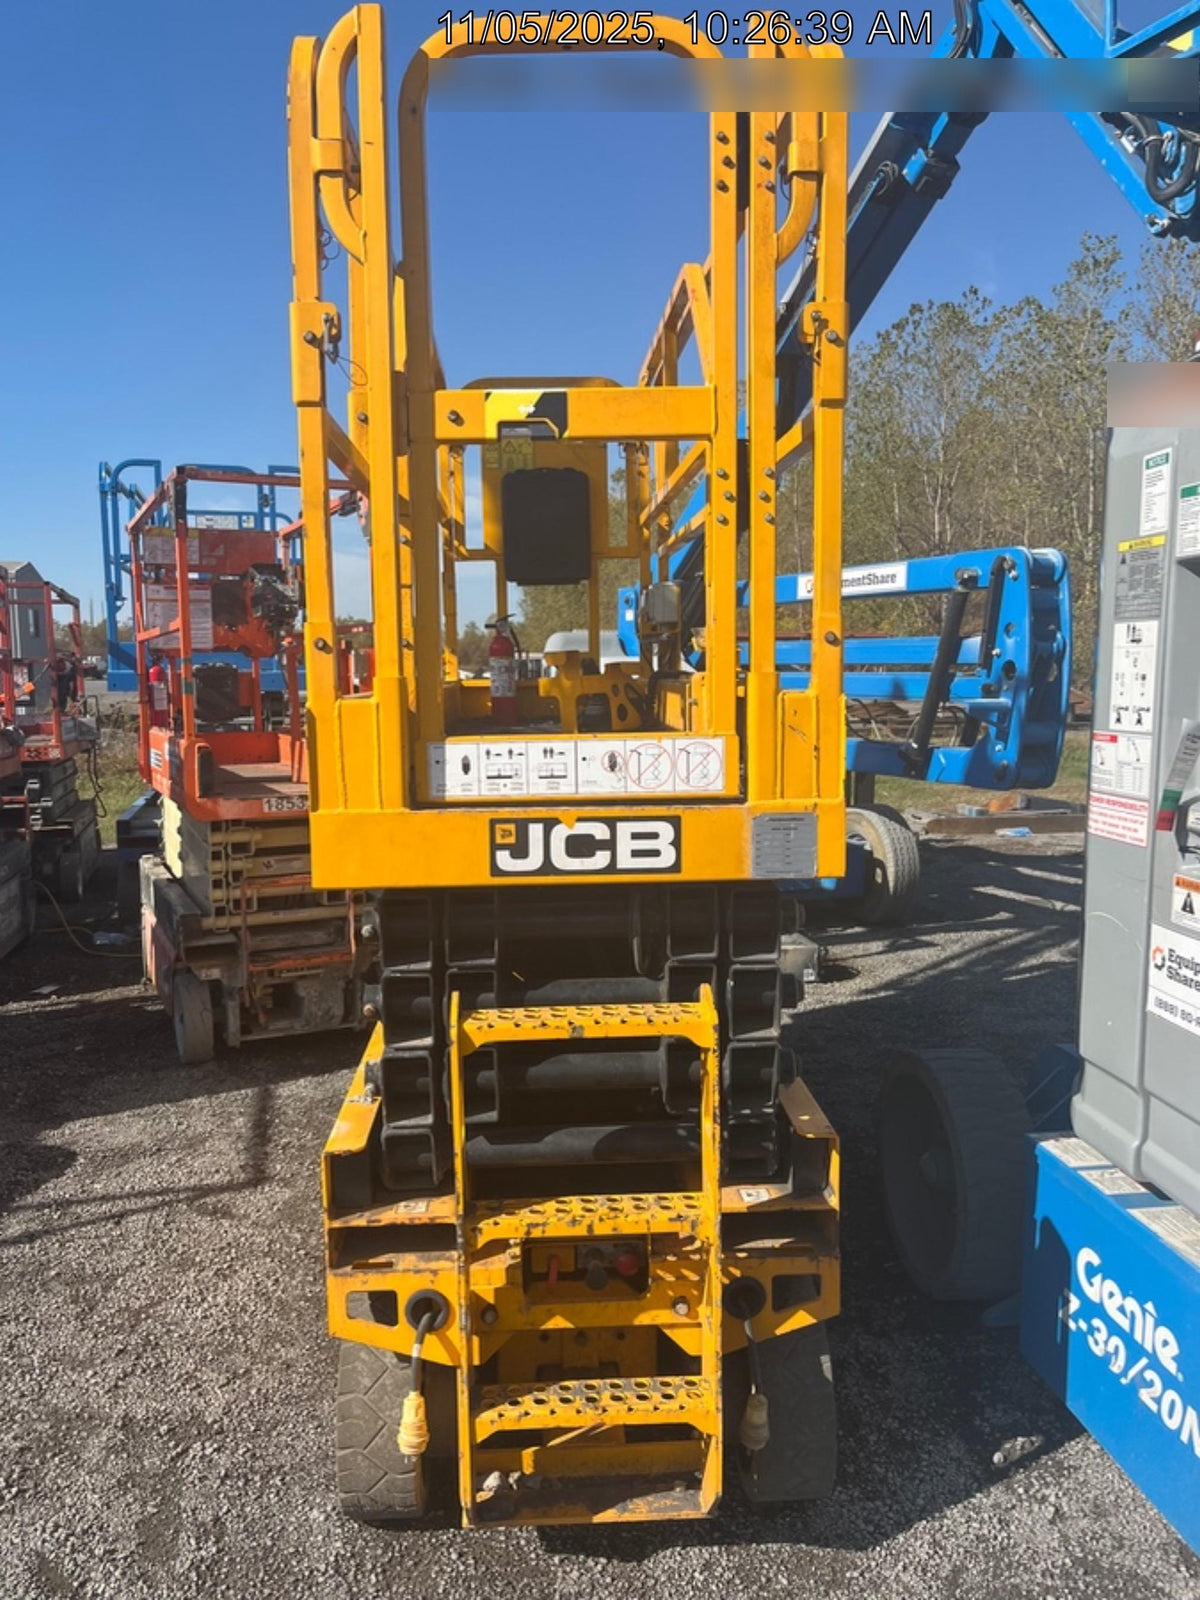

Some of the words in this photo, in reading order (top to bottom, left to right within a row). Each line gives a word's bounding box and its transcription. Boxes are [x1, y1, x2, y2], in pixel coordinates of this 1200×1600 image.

[494, 820, 677, 874] JCB
[1166, 965, 1200, 993] Share
[1076, 1246, 1181, 1378] Genie
